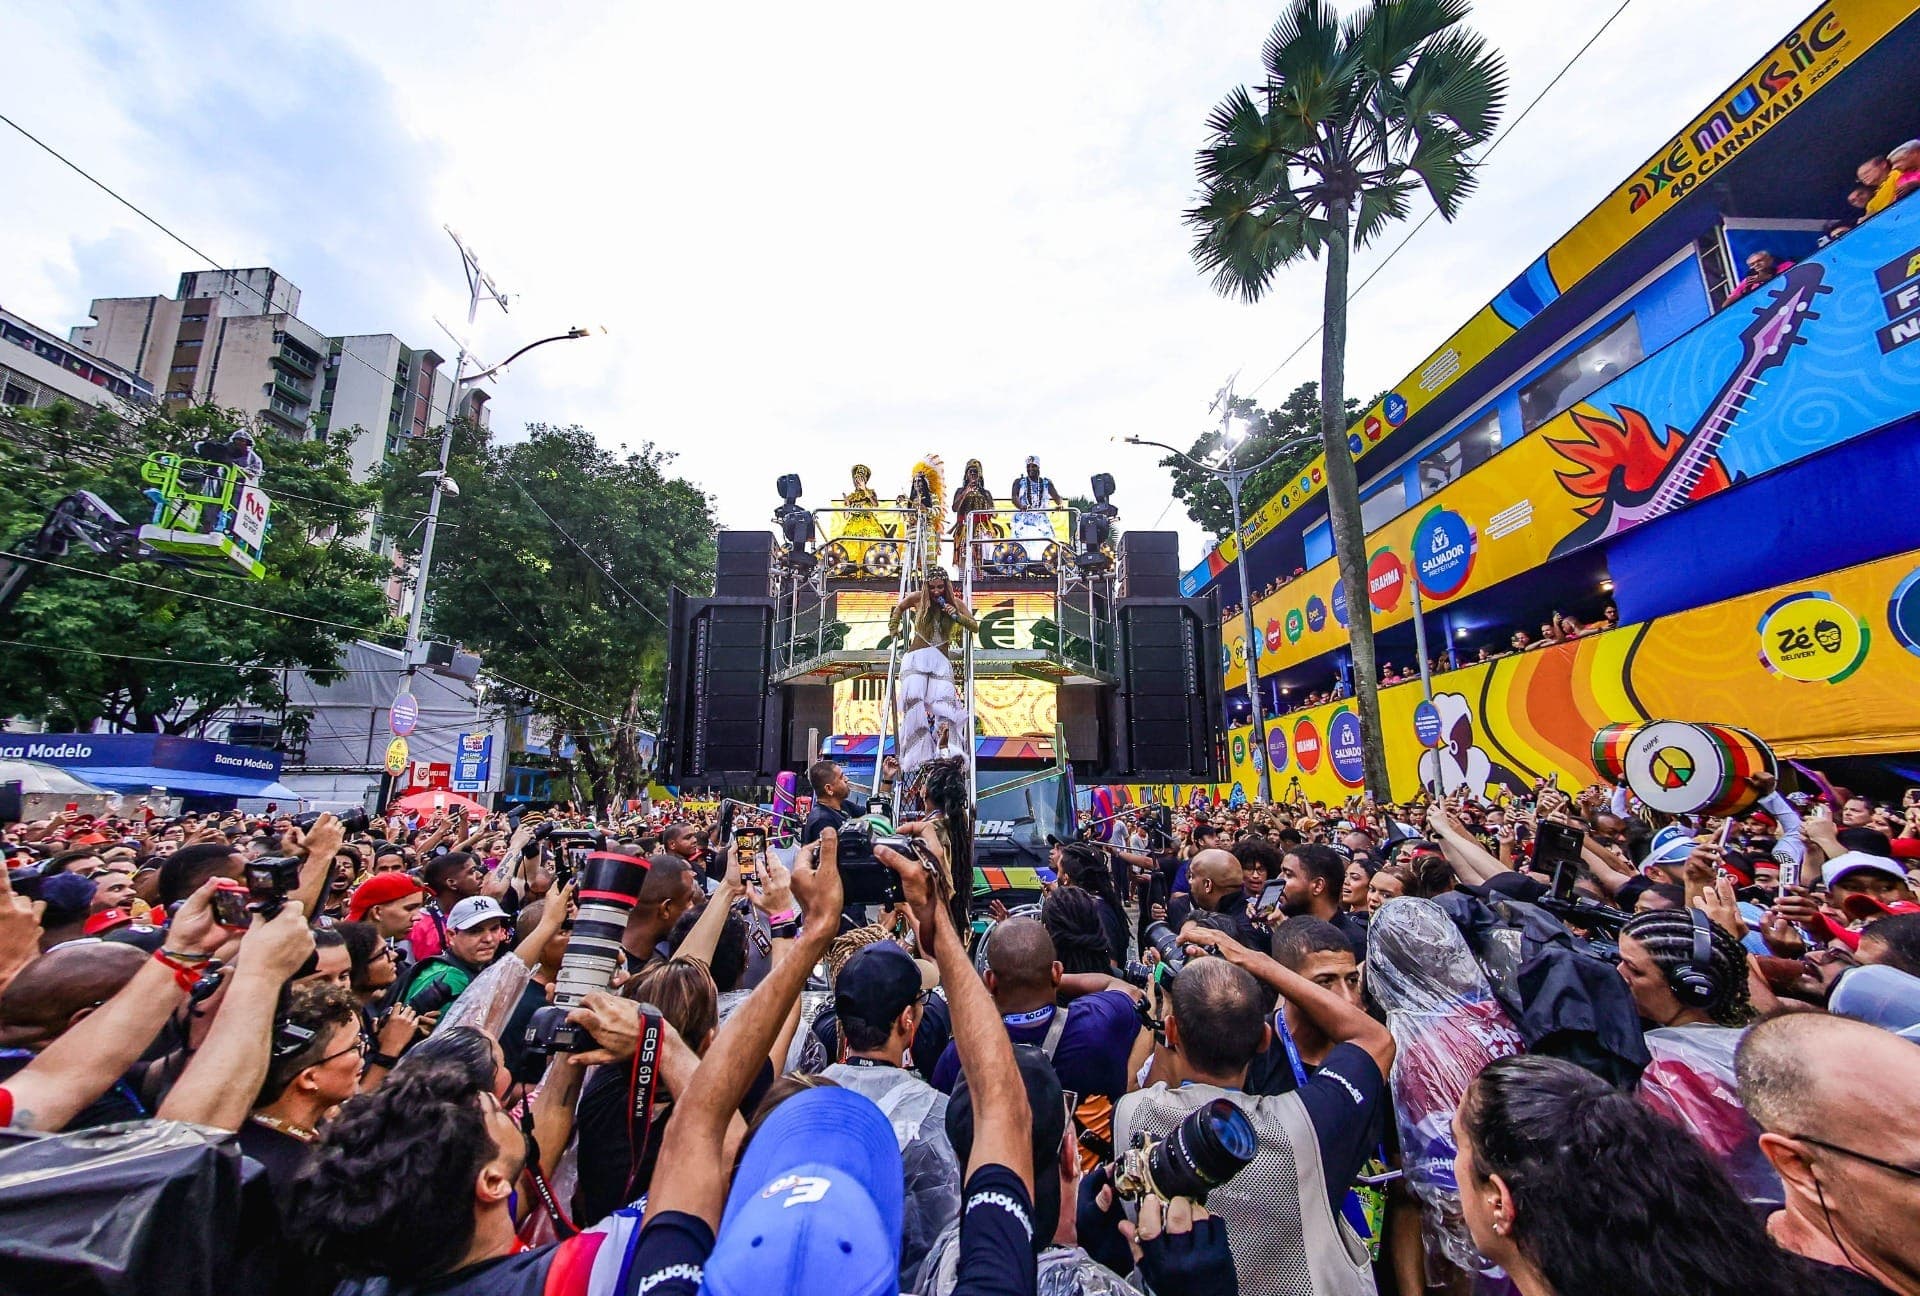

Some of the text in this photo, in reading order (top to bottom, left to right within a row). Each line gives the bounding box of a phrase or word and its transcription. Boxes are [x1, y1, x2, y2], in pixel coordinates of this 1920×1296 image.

[1670, 83, 1803, 199] 40 CARNAVAIS
[1422, 543, 1465, 573] SALVADOR
[1428, 558, 1460, 577] PREFEITURA
[1369, 567, 1400, 594] BRAHMA
[1776, 626, 1814, 654] Zé
[1780, 649, 1816, 662] DELIVERY
[27, 743, 92, 758] Modelo
[1334, 746, 1362, 759] SALVADO
[215, 753, 274, 770] Banca Modelo
[641, 1027, 658, 1063] EOS
[638, 1065, 652, 1085] 6D
[635, 1087, 646, 1110] Mark
